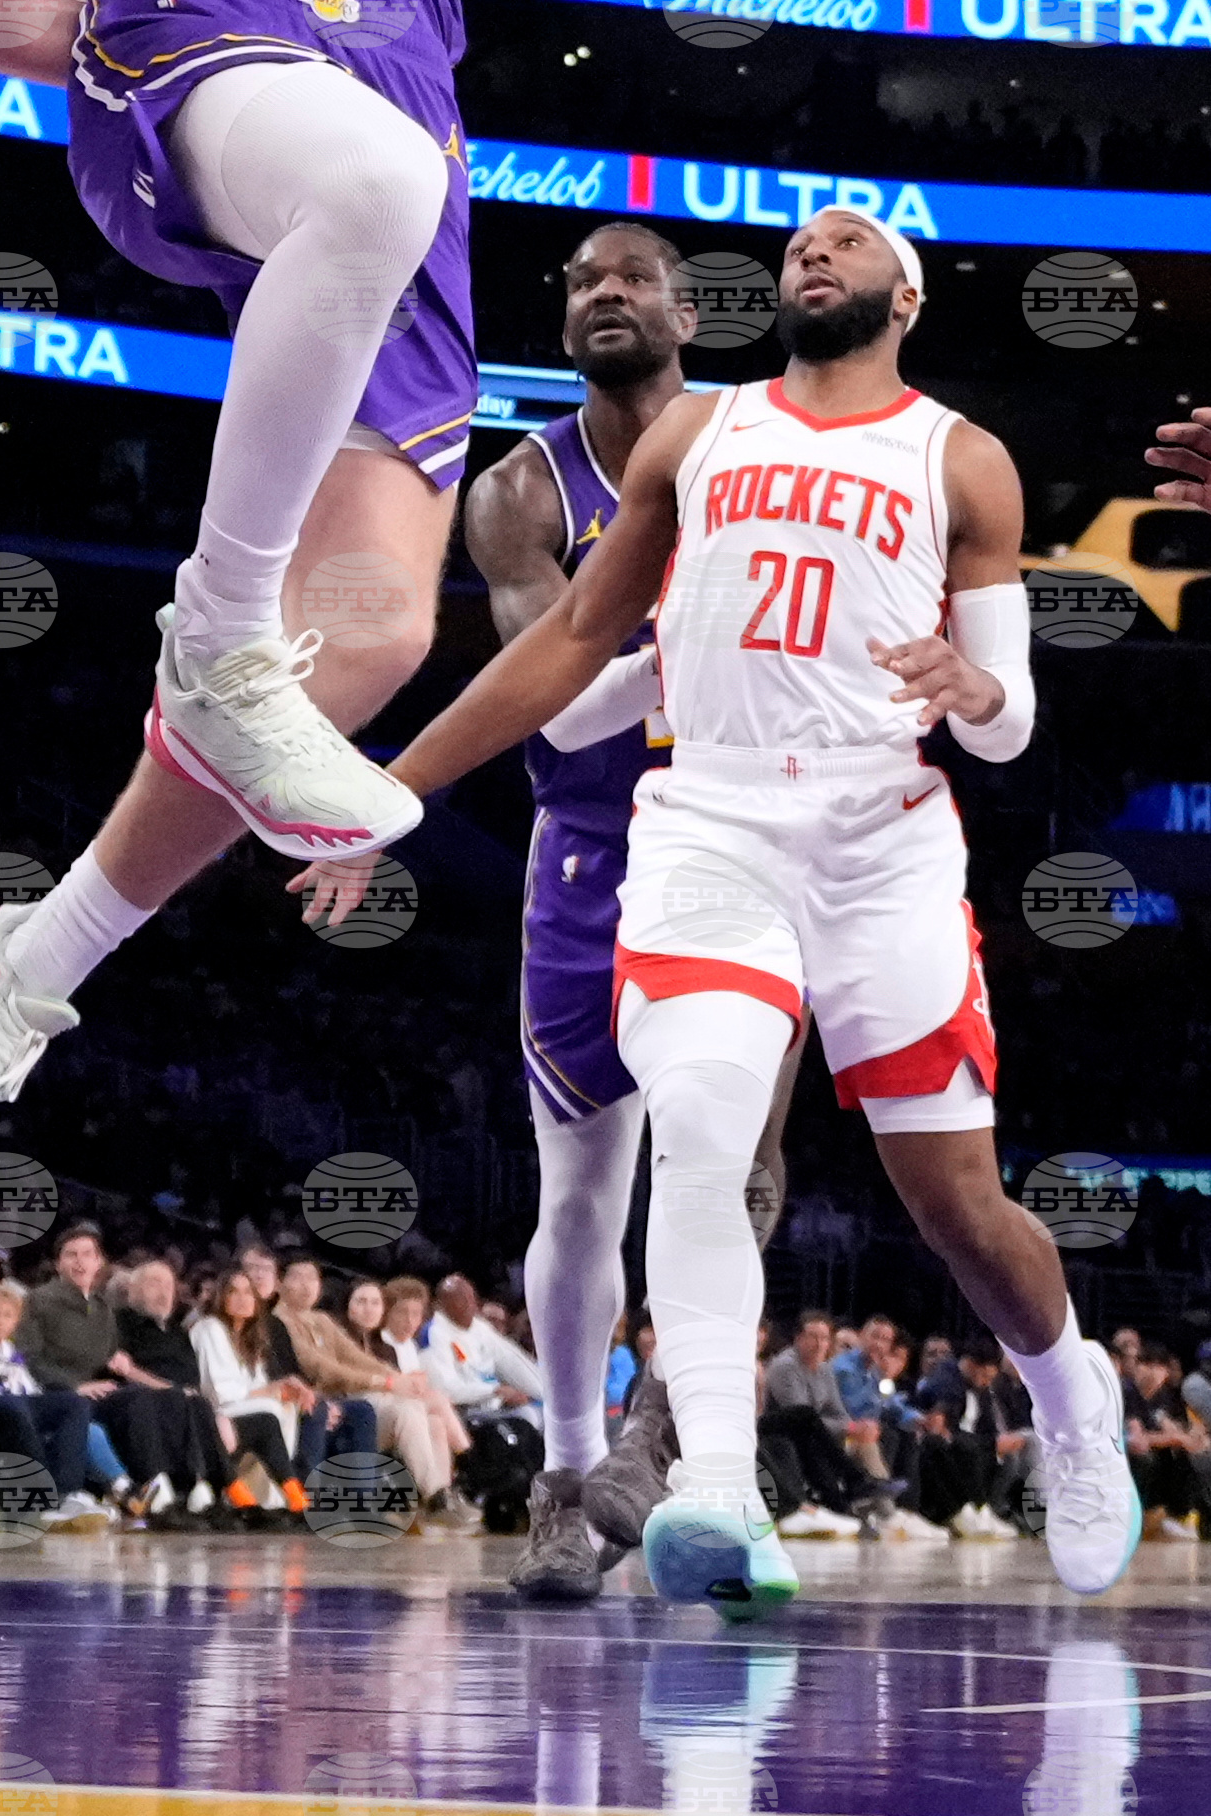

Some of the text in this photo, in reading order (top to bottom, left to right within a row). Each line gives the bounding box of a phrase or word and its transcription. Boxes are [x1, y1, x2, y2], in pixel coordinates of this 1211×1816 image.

[683, 162, 938, 240] ULTRA
[705, 463, 913, 561] ROCKETS
[740, 550, 835, 658] 20
